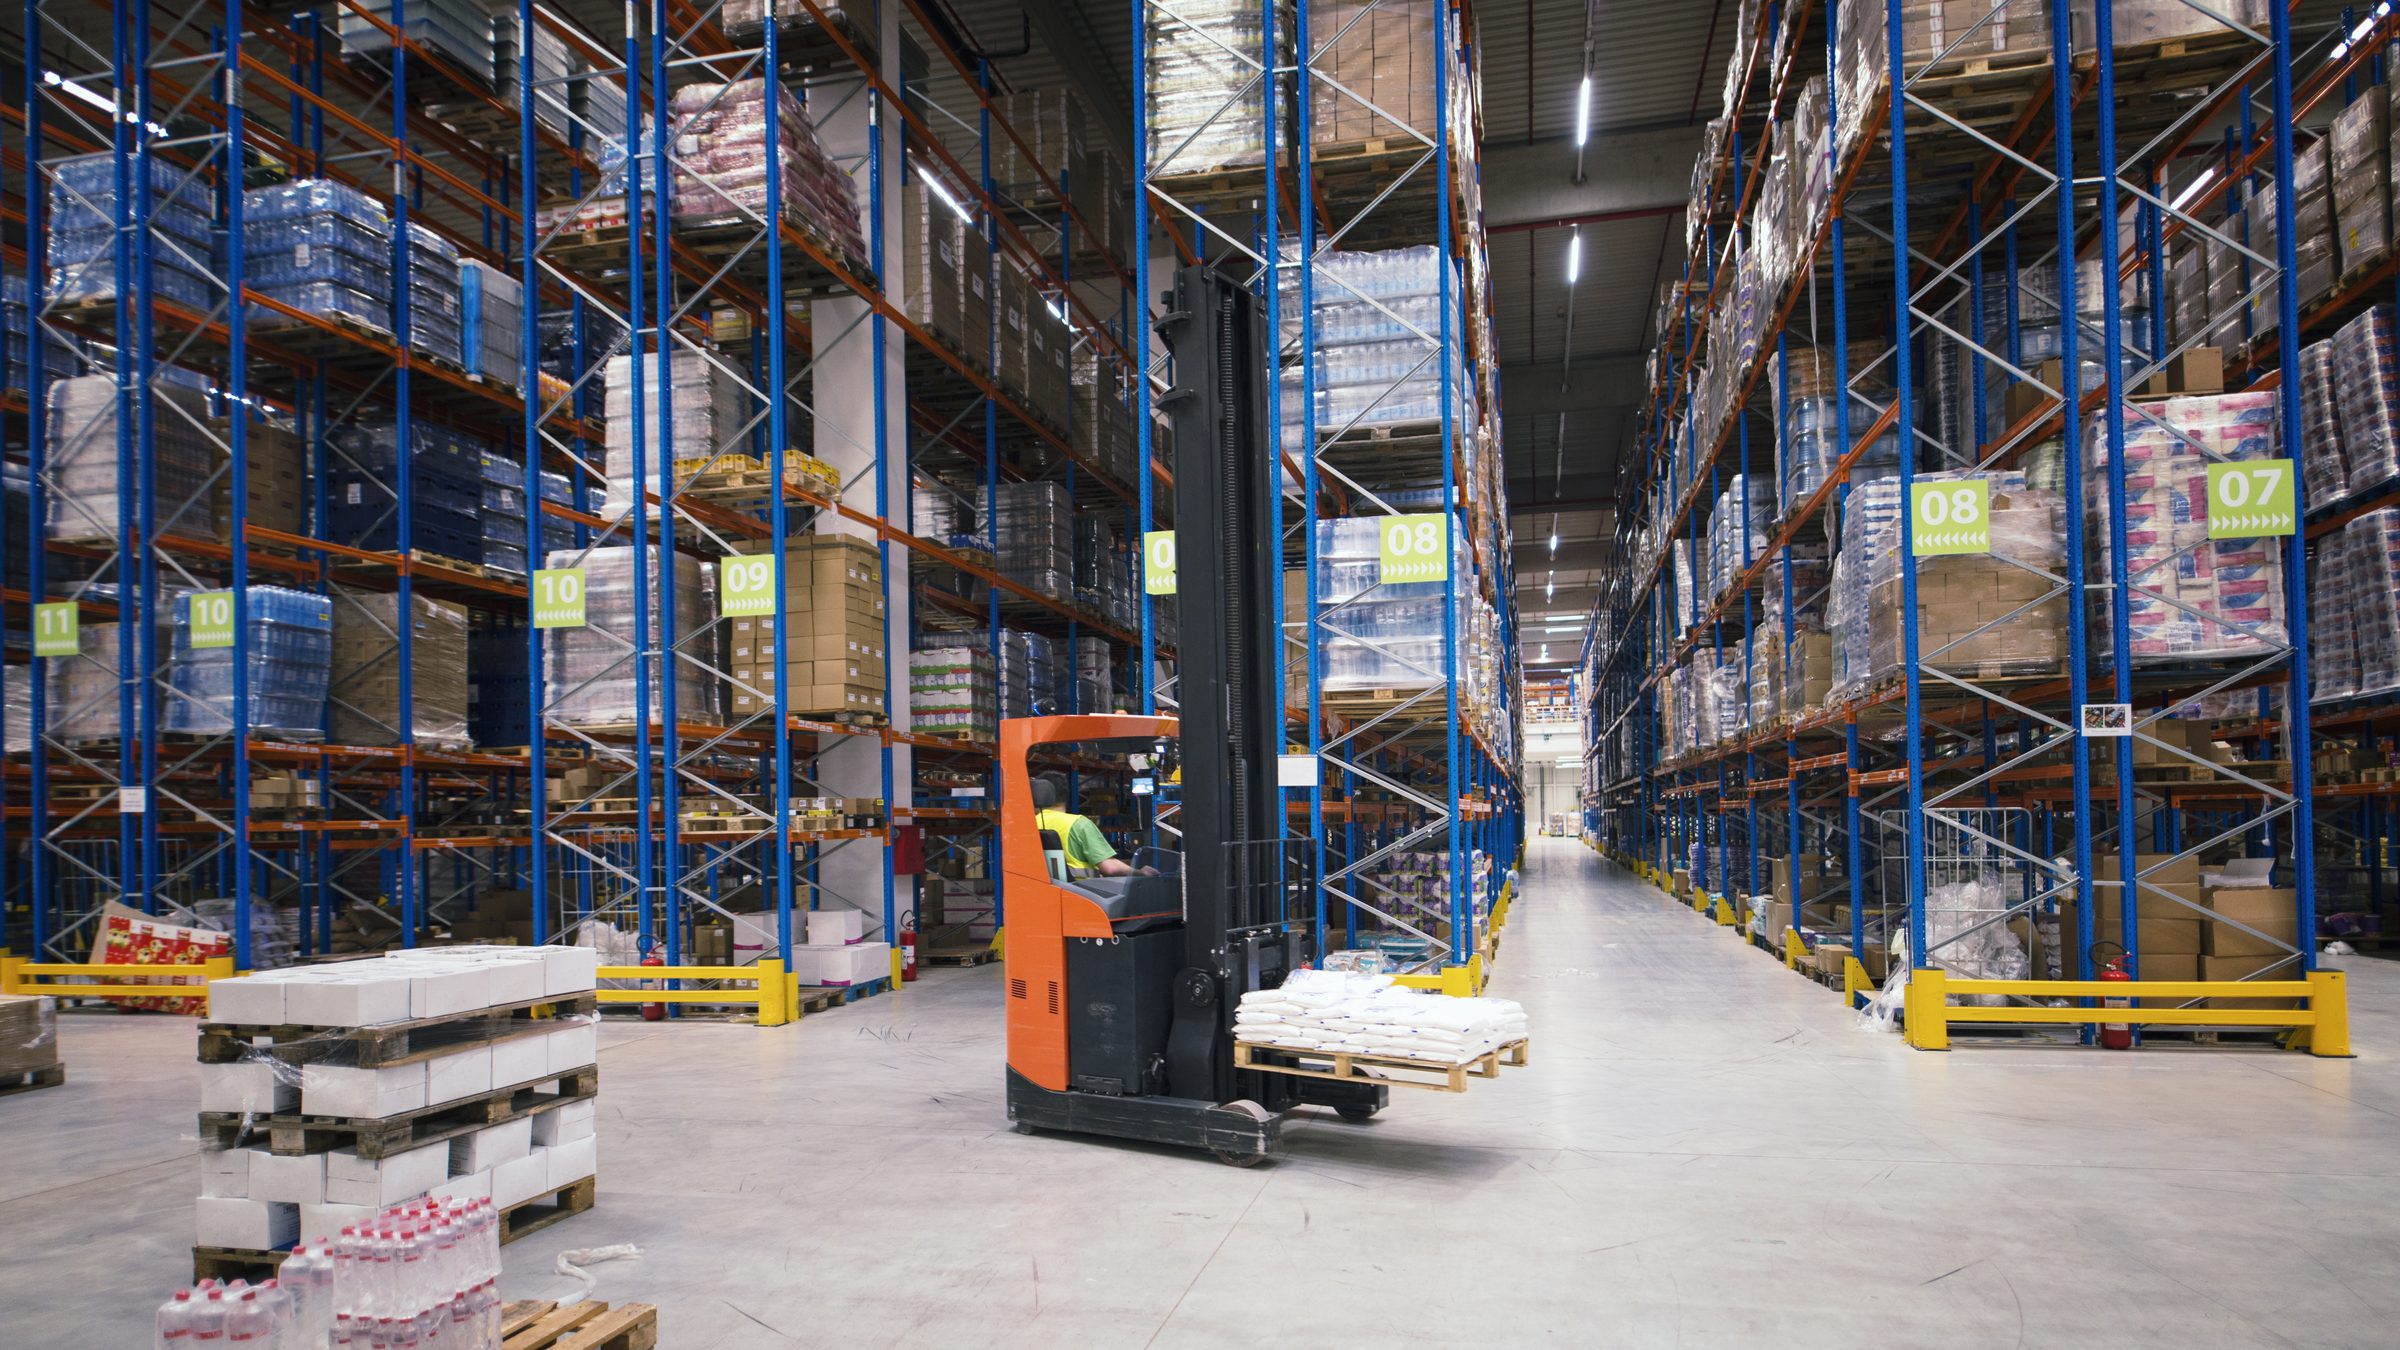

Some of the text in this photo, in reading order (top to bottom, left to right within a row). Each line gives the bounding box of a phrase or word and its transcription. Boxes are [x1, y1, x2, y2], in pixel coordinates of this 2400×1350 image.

[2218, 468, 2283, 508] 07
[1920, 488, 1980, 527] 08
[1387, 521, 1440, 558] 08
[541, 574, 580, 605] 10
[726, 561, 770, 594] 09
[41, 607, 70, 635] 11
[196, 597, 231, 627] 10
